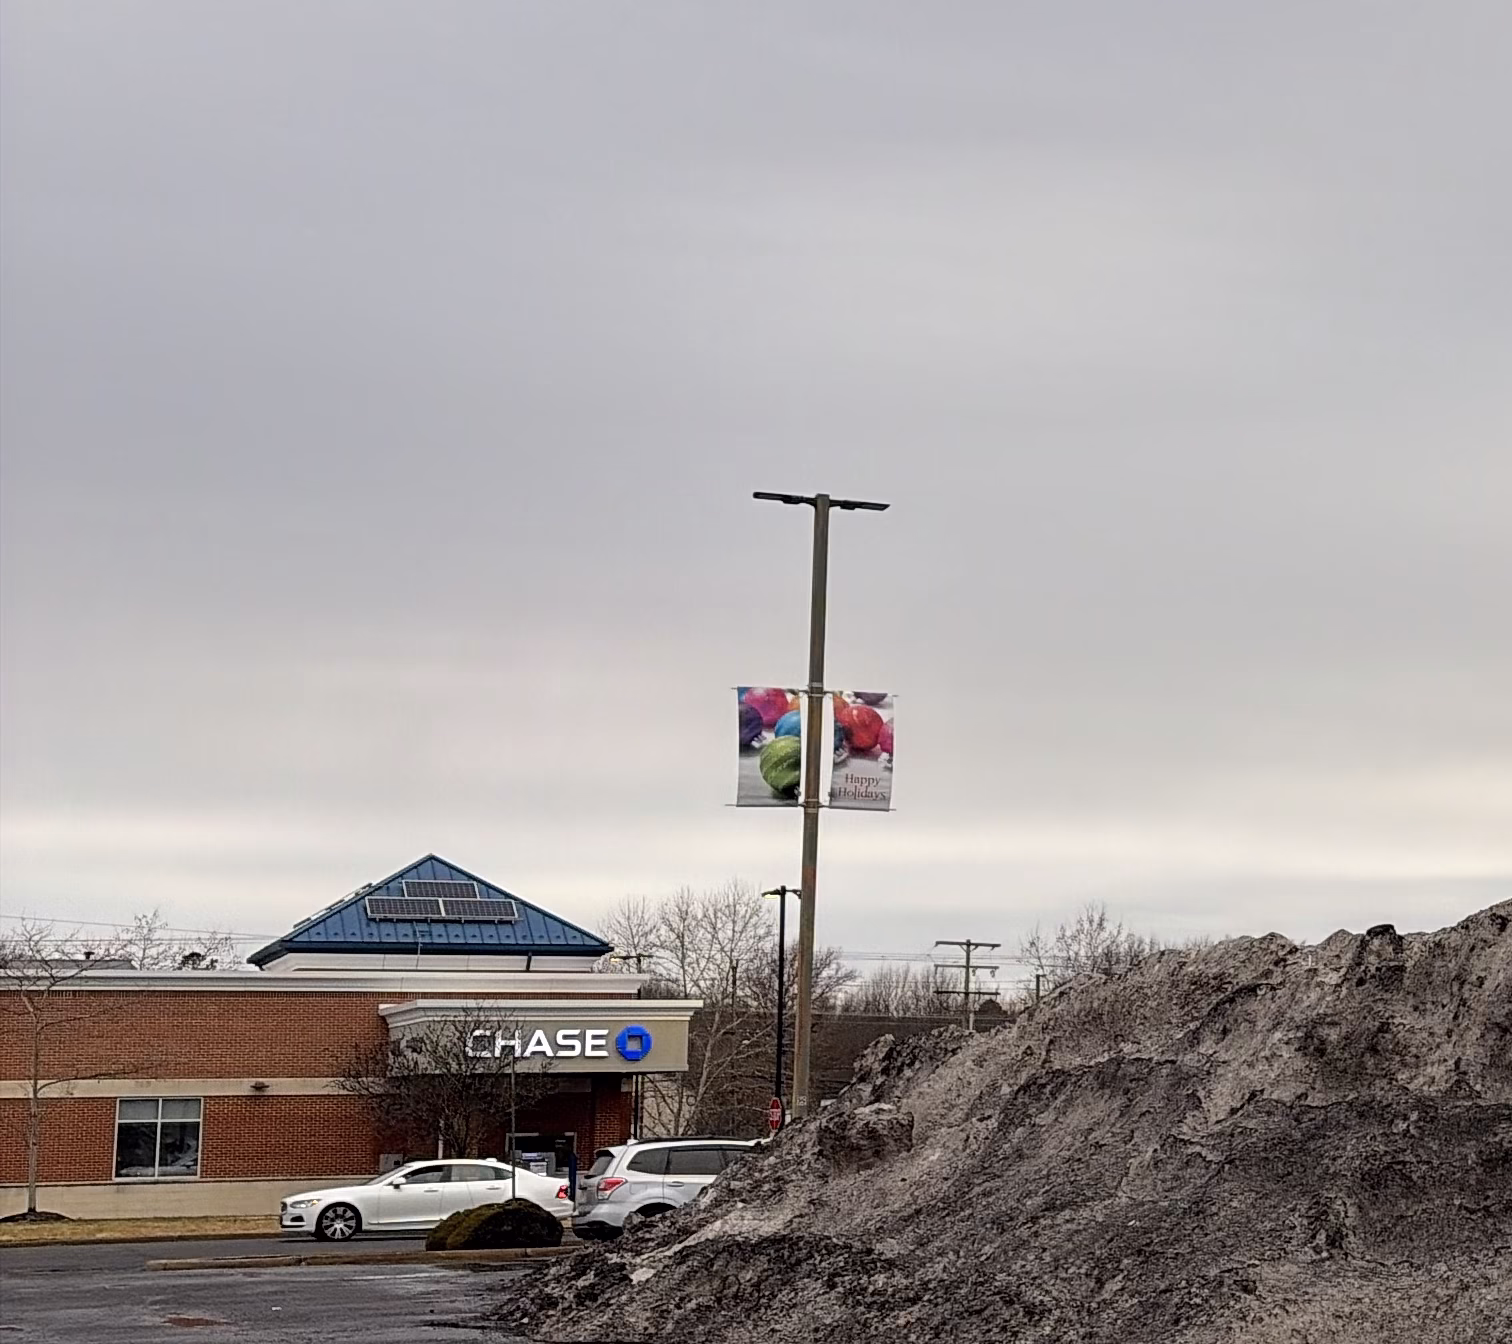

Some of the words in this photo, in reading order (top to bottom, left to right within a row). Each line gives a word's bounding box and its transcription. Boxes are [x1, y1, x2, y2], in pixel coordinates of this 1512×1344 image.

[845, 773, 880, 787] Happy
[838, 785, 886, 800] Holidays
[465, 1029, 609, 1058] CHASE
